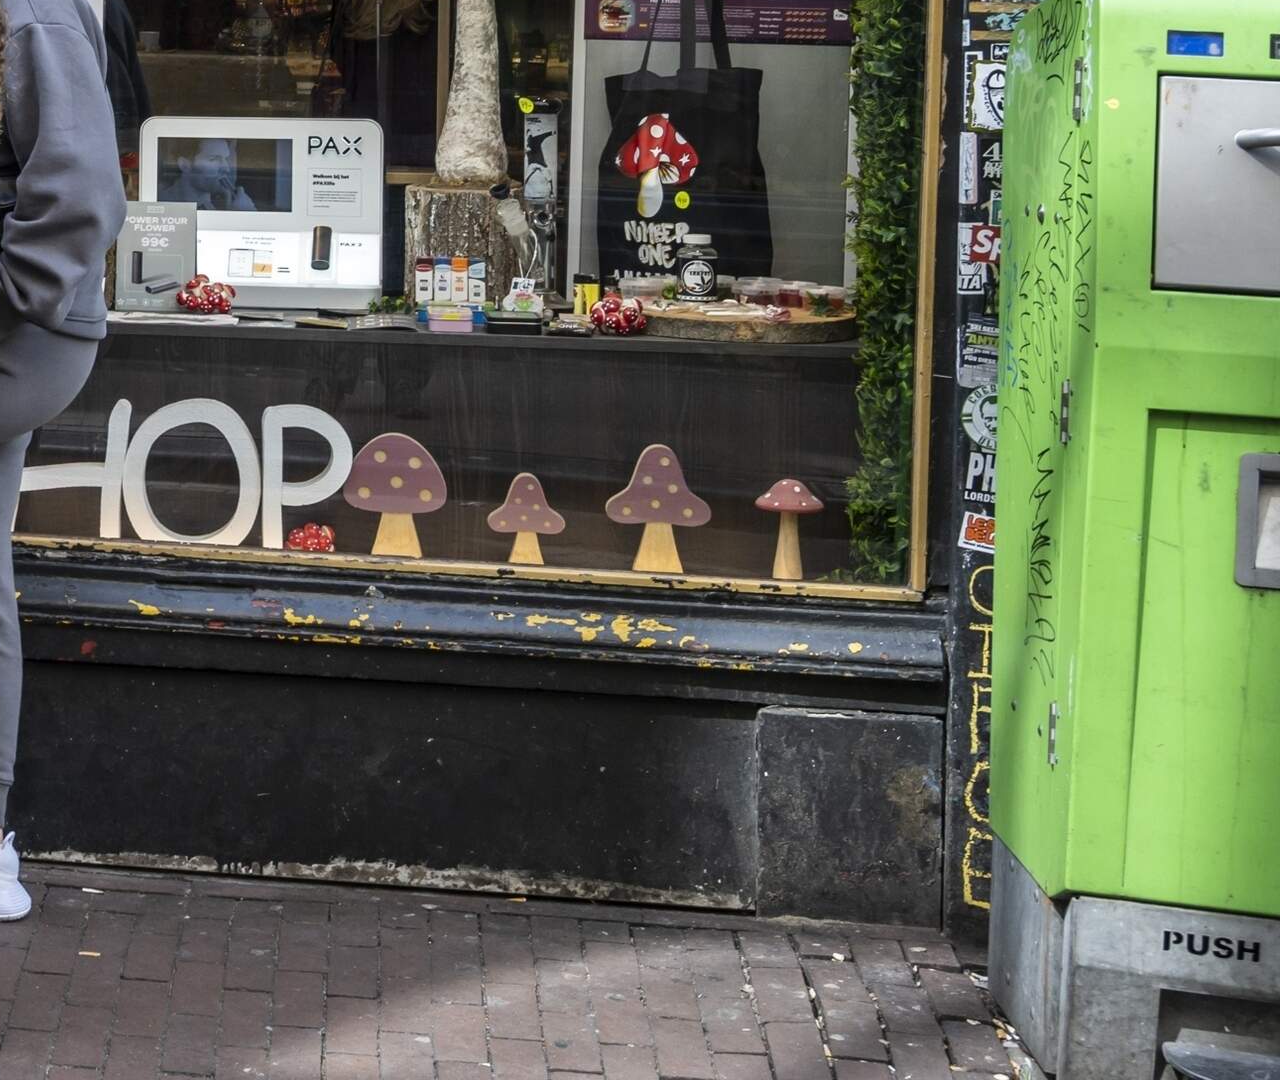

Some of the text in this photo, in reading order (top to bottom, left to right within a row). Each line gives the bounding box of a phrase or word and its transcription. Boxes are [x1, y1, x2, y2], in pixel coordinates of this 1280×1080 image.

[307, 135, 363, 156] PAX
[134, 223, 177, 233] FLOWER
[160, 216, 189, 225] YOUR
[140, 236, 170, 248] 99€
[14, 397, 353, 549] HOP
[1161, 929, 1262, 964] PUSH
